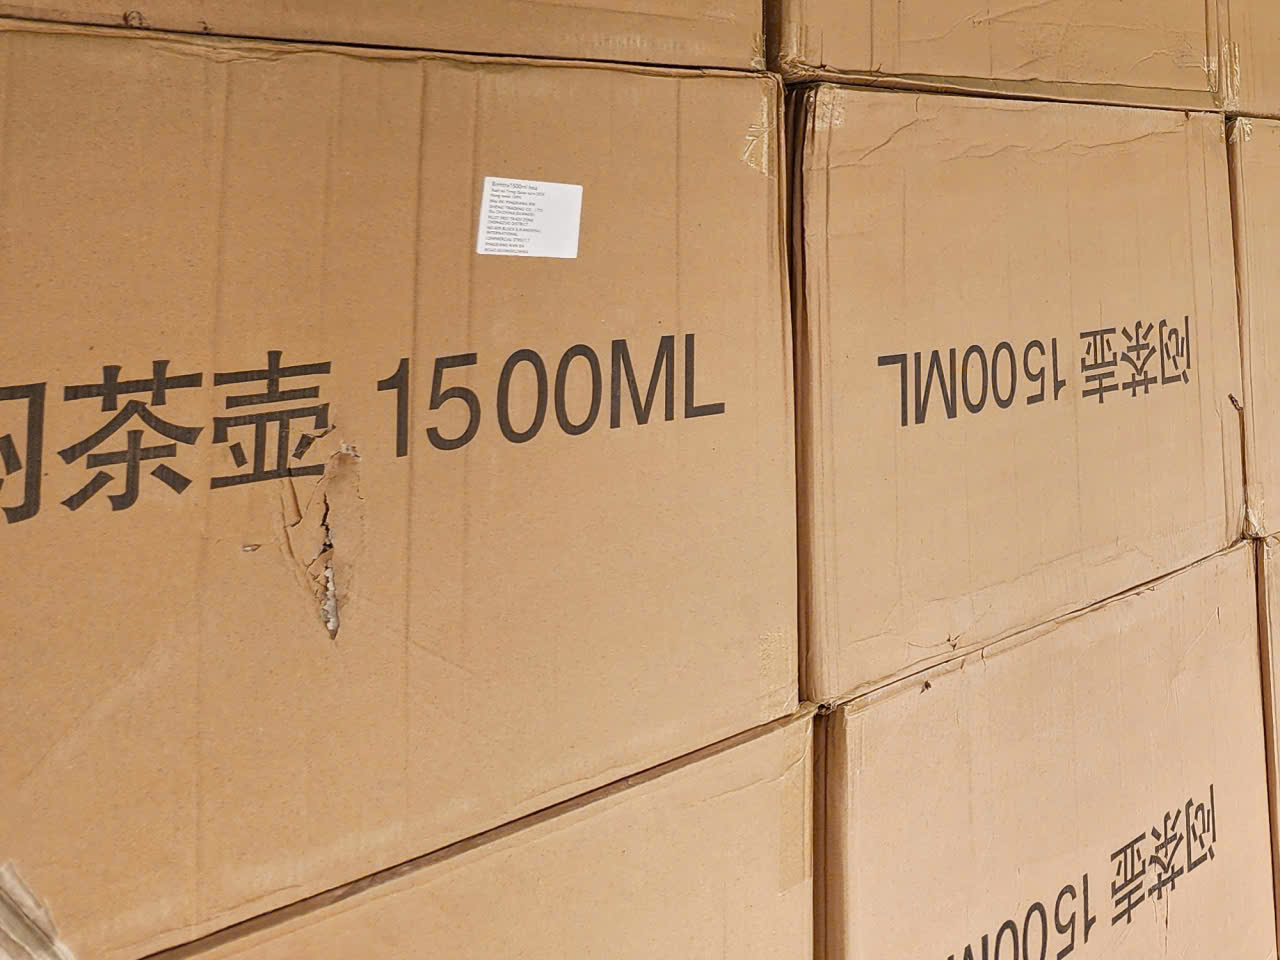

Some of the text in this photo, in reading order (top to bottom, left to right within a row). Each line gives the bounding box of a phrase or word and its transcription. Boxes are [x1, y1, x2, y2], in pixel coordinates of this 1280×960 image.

[377, 333, 726, 458] 1500ML
[878, 315, 1191, 427] 闷茶壶 1500ML
[1110, 783, 1217, 927] 闷茶壶
